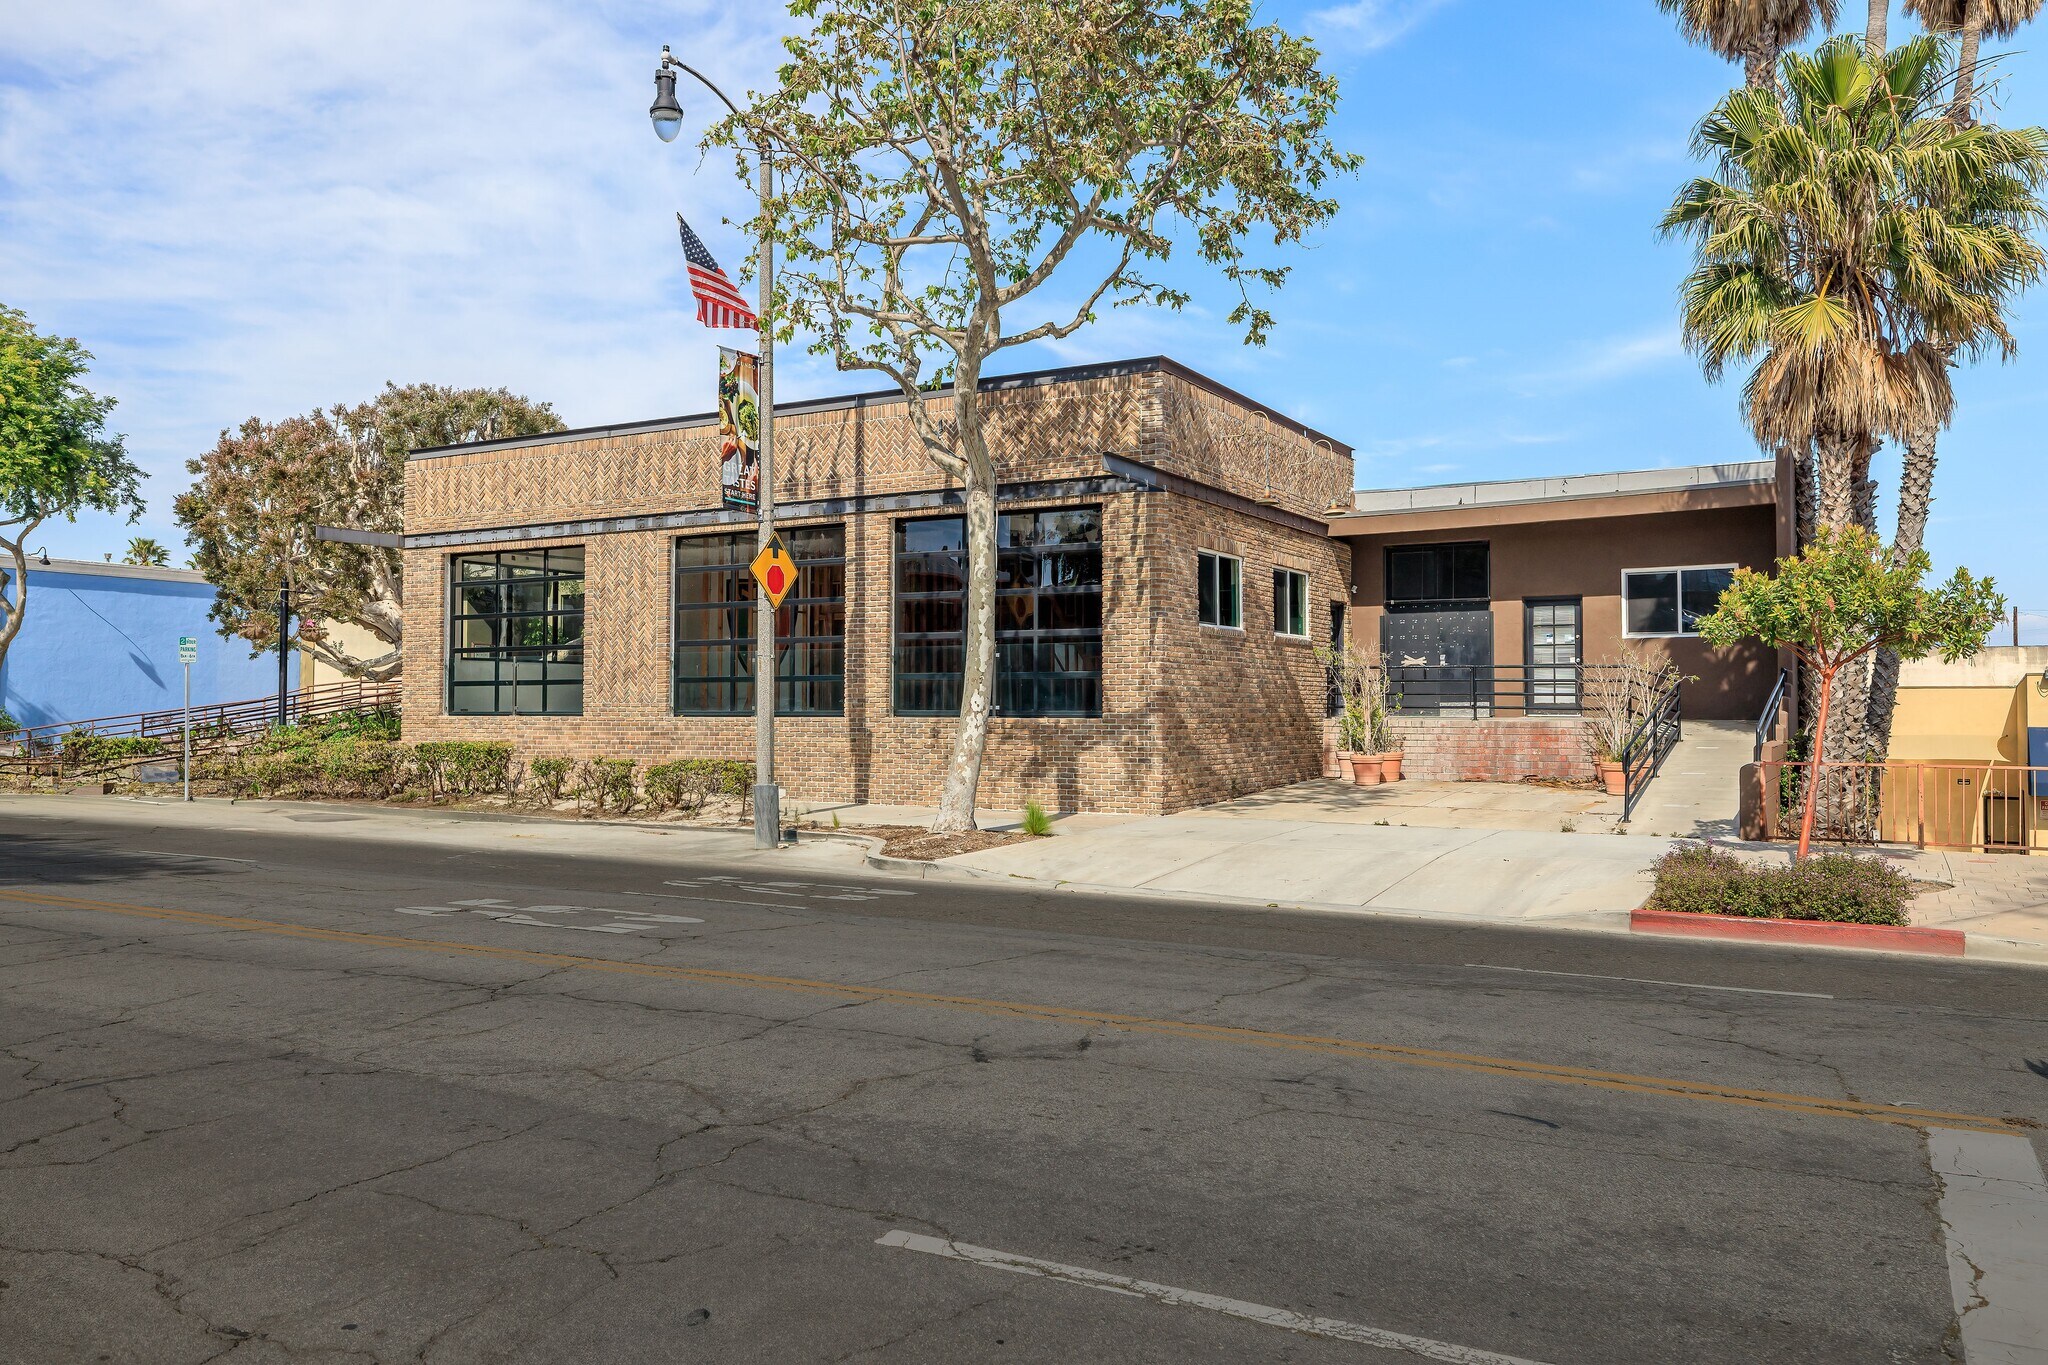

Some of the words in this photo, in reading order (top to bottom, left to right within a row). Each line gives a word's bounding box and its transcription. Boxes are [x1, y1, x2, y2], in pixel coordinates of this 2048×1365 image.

[724, 462, 756, 477] GREAT
[724, 488, 741, 497] START
[741, 491, 756, 501] HERE
